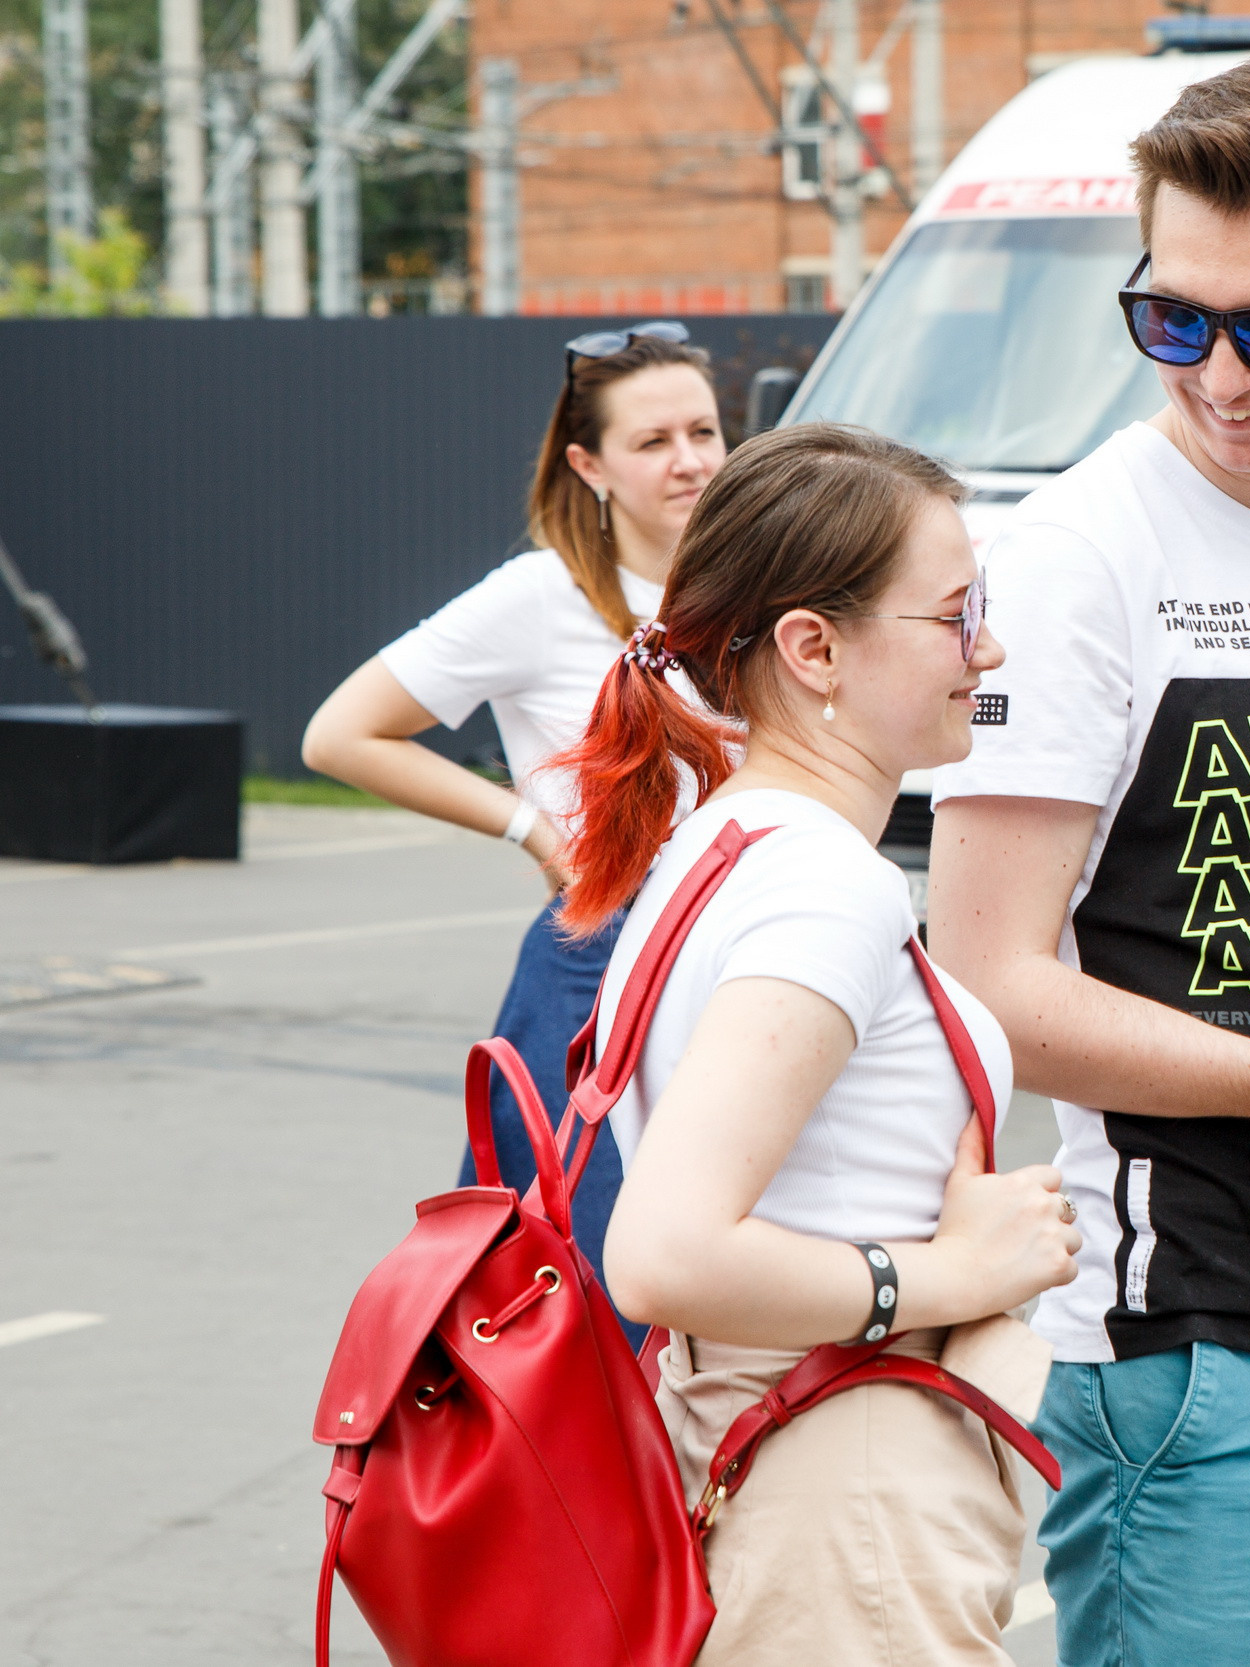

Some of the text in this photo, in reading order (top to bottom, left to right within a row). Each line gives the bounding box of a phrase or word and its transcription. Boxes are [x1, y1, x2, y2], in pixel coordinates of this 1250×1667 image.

[977, 178, 1138, 209] РЕАН
[1157, 599, 1178, 615] AT
[1182, 602, 1206, 616] HE
[1209, 601, 1244, 616] END
[1194, 637, 1226, 650] AND
